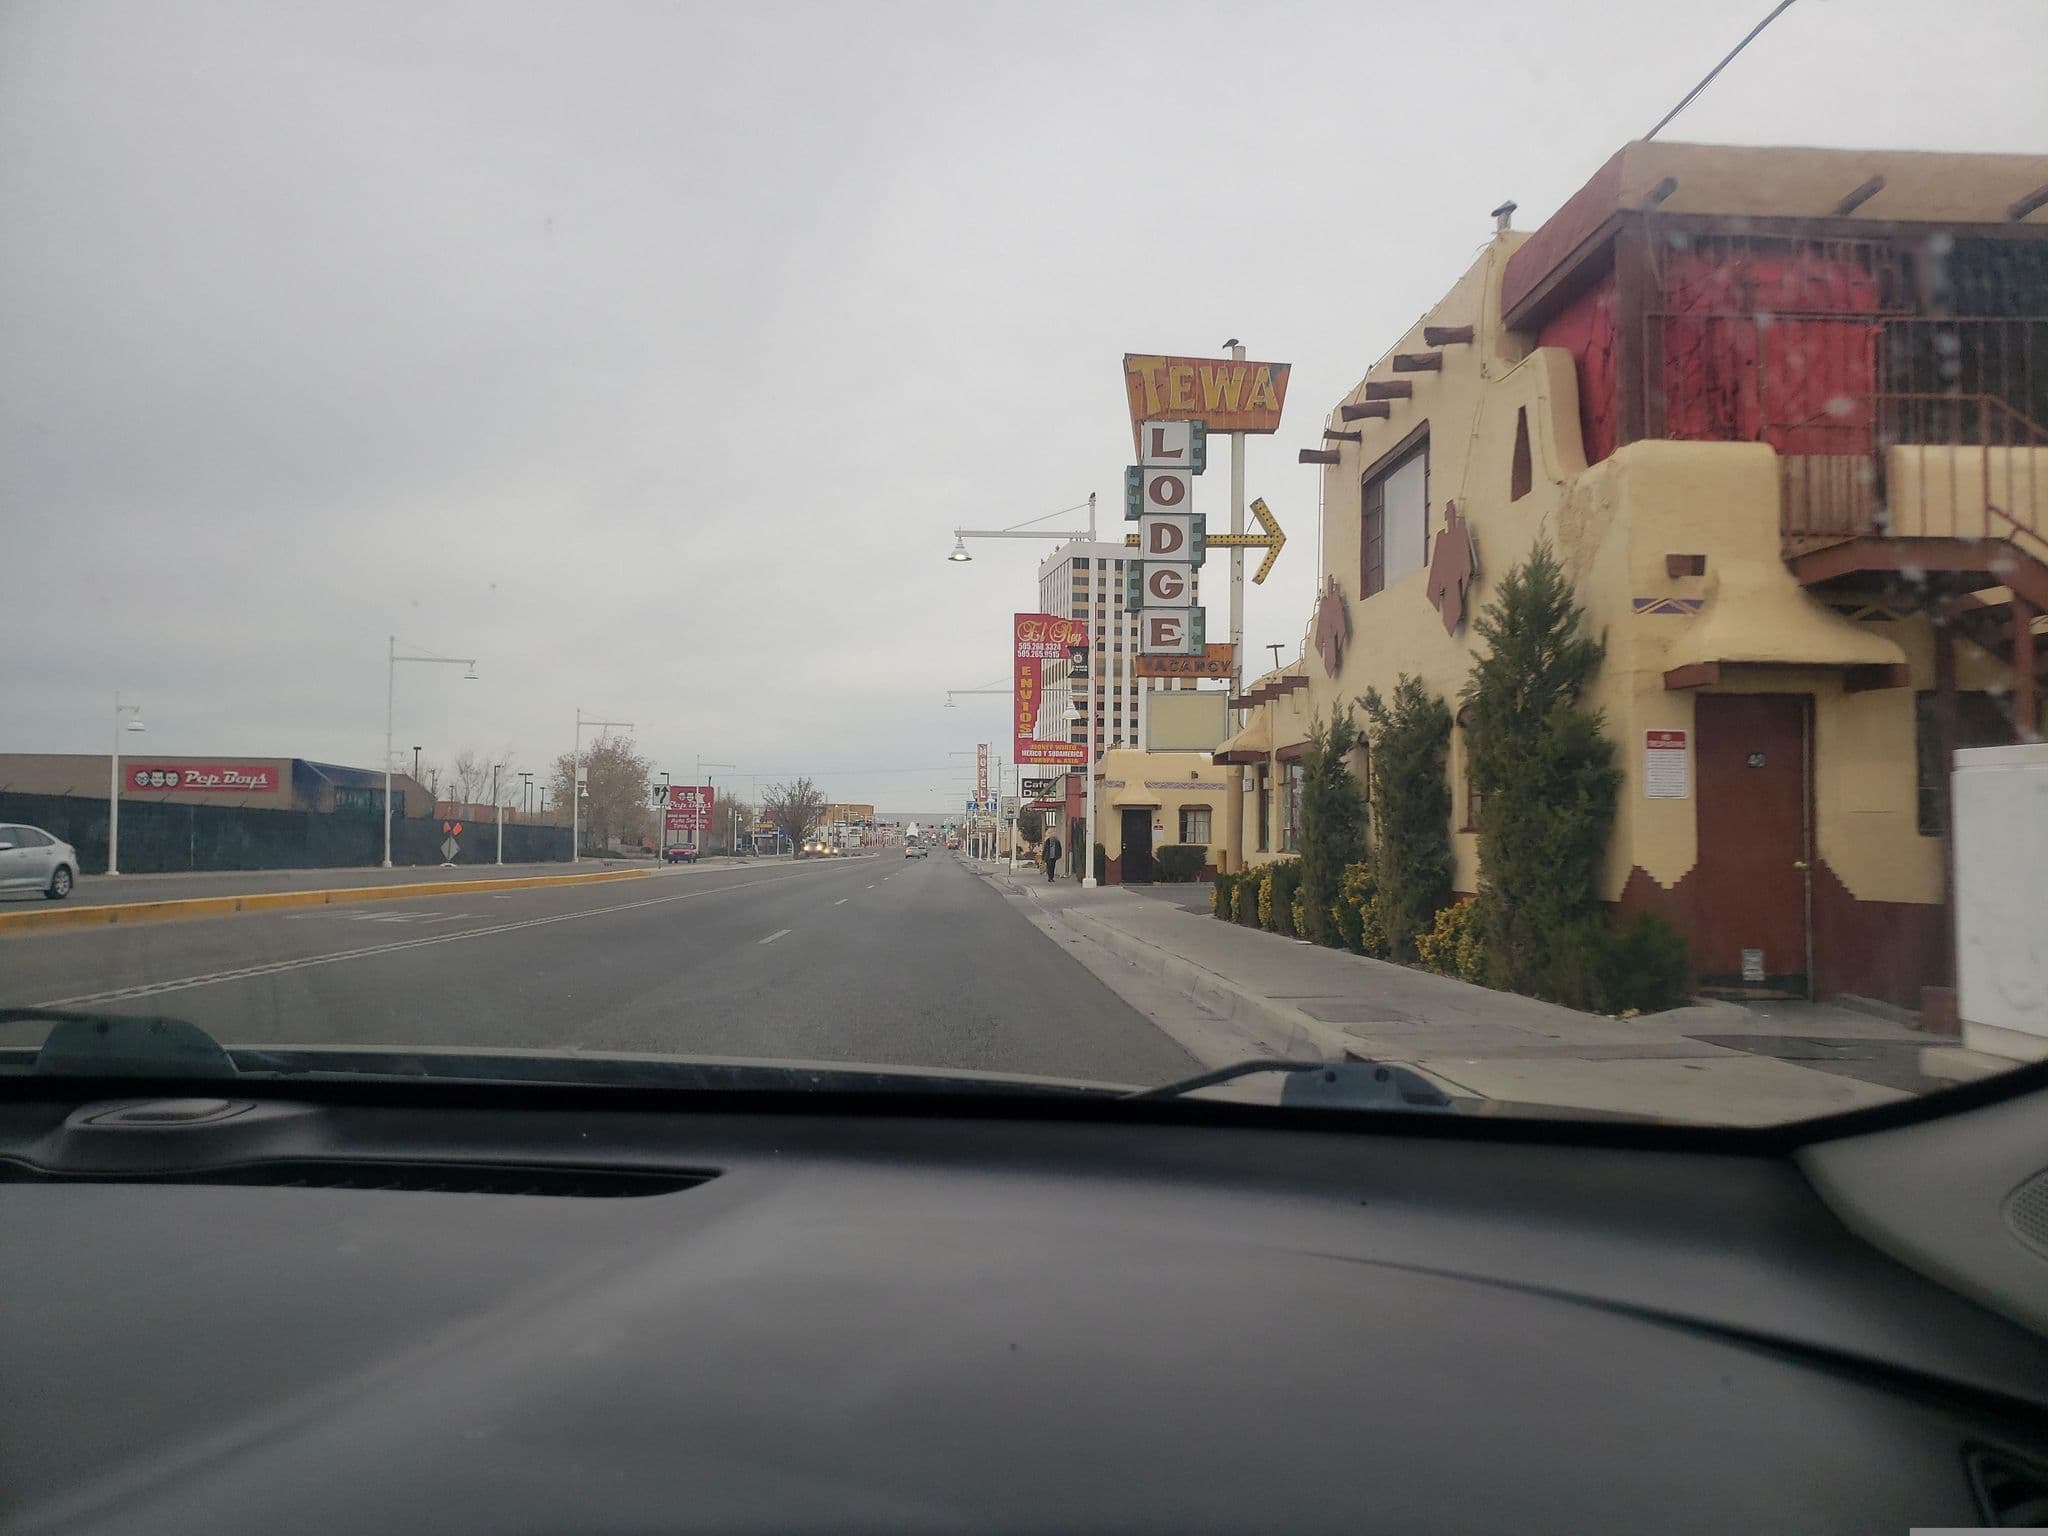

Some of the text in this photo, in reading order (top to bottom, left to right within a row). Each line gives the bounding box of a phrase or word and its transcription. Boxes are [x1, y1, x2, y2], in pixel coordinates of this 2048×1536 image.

[1128, 357, 1279, 415] TEWA
[1149, 428, 1185, 646] LODGE
[1017, 620, 1082, 646] El Rey
[1144, 658, 1231, 672] VACANCY
[185, 770, 268, 789] Pep Boys
